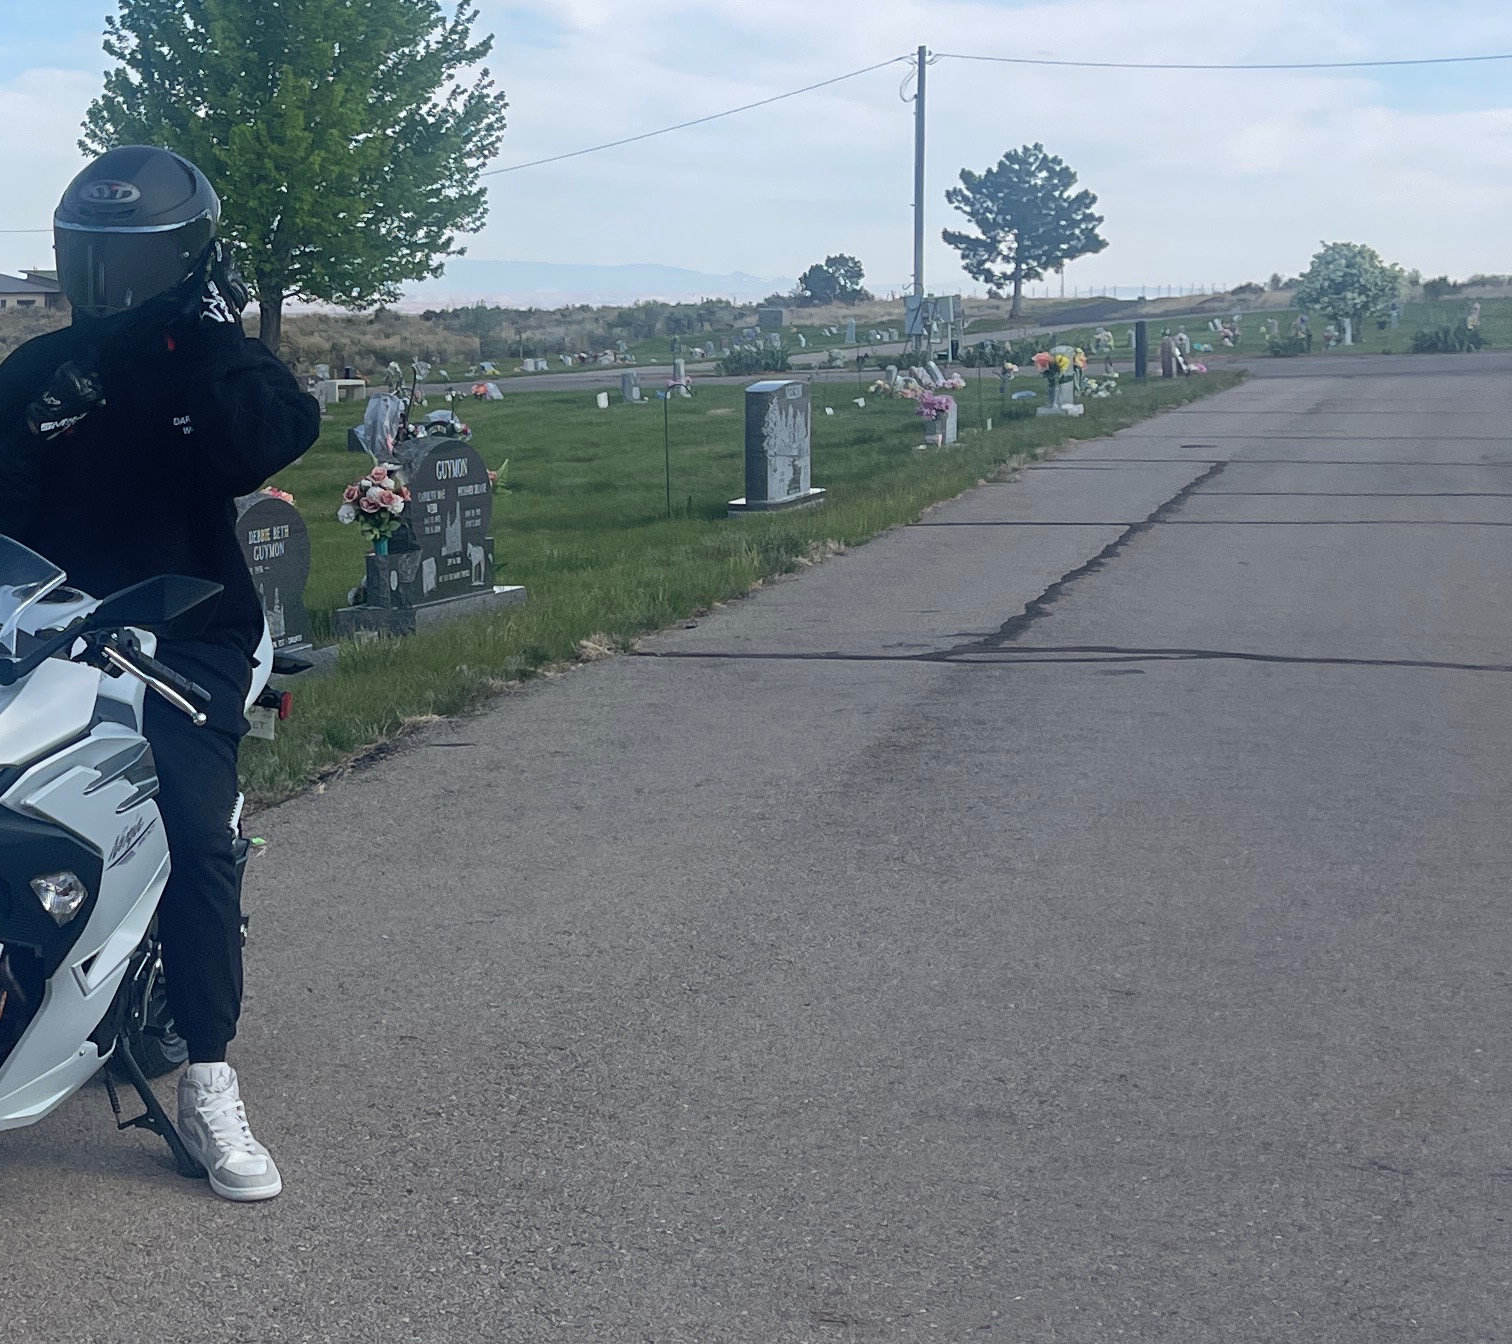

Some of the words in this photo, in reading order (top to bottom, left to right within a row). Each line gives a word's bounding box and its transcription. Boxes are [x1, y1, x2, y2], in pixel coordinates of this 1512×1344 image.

[435, 457, 468, 481] GUYMON
[248, 527, 271, 545] DEBBIE
[272, 525, 289, 541] BETH
[253, 541, 285, 562] GUYMON
